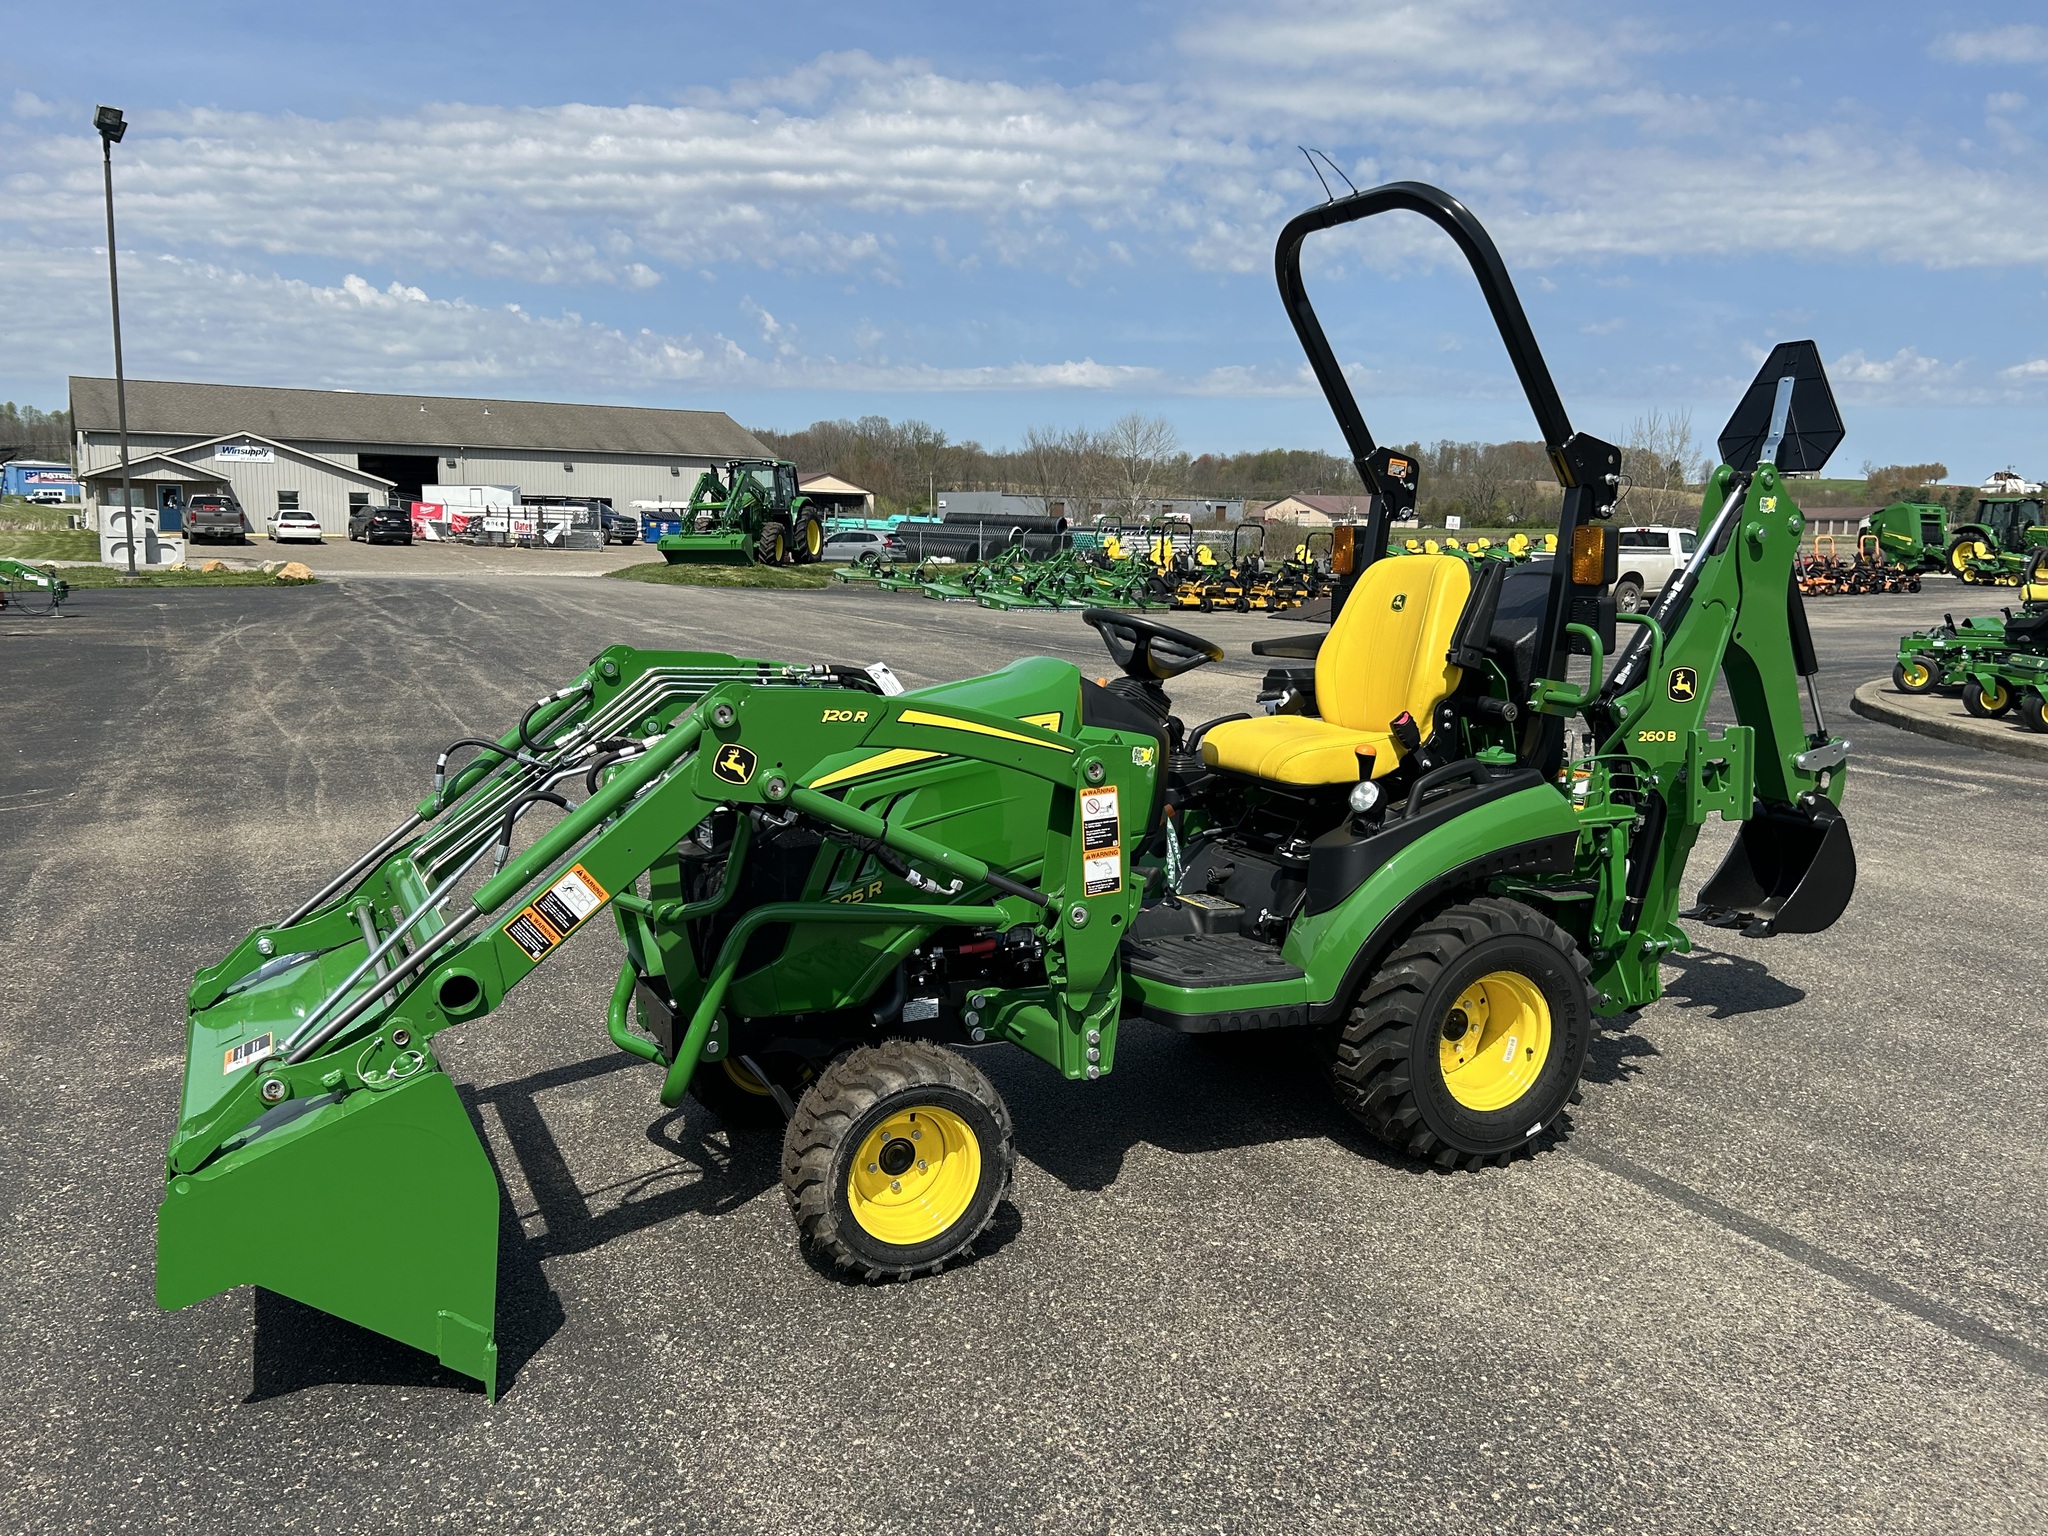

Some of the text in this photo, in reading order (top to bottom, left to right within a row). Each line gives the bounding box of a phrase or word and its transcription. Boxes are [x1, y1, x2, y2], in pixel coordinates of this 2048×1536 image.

[222, 446, 270, 457] Winsupply
[514, 520, 532, 533] Oatey
[822, 709, 869, 723] 120 R
[1638, 730, 1677, 742] 260 B
[1087, 786, 1115, 796] WARNING
[1090, 849, 1119, 859] WARNING
[582, 874, 605, 898] WARNING
[830, 880, 883, 903] 25 R
[533, 917, 556, 941] WARNING
[1551, 974, 1579, 1088] CARLISLE
